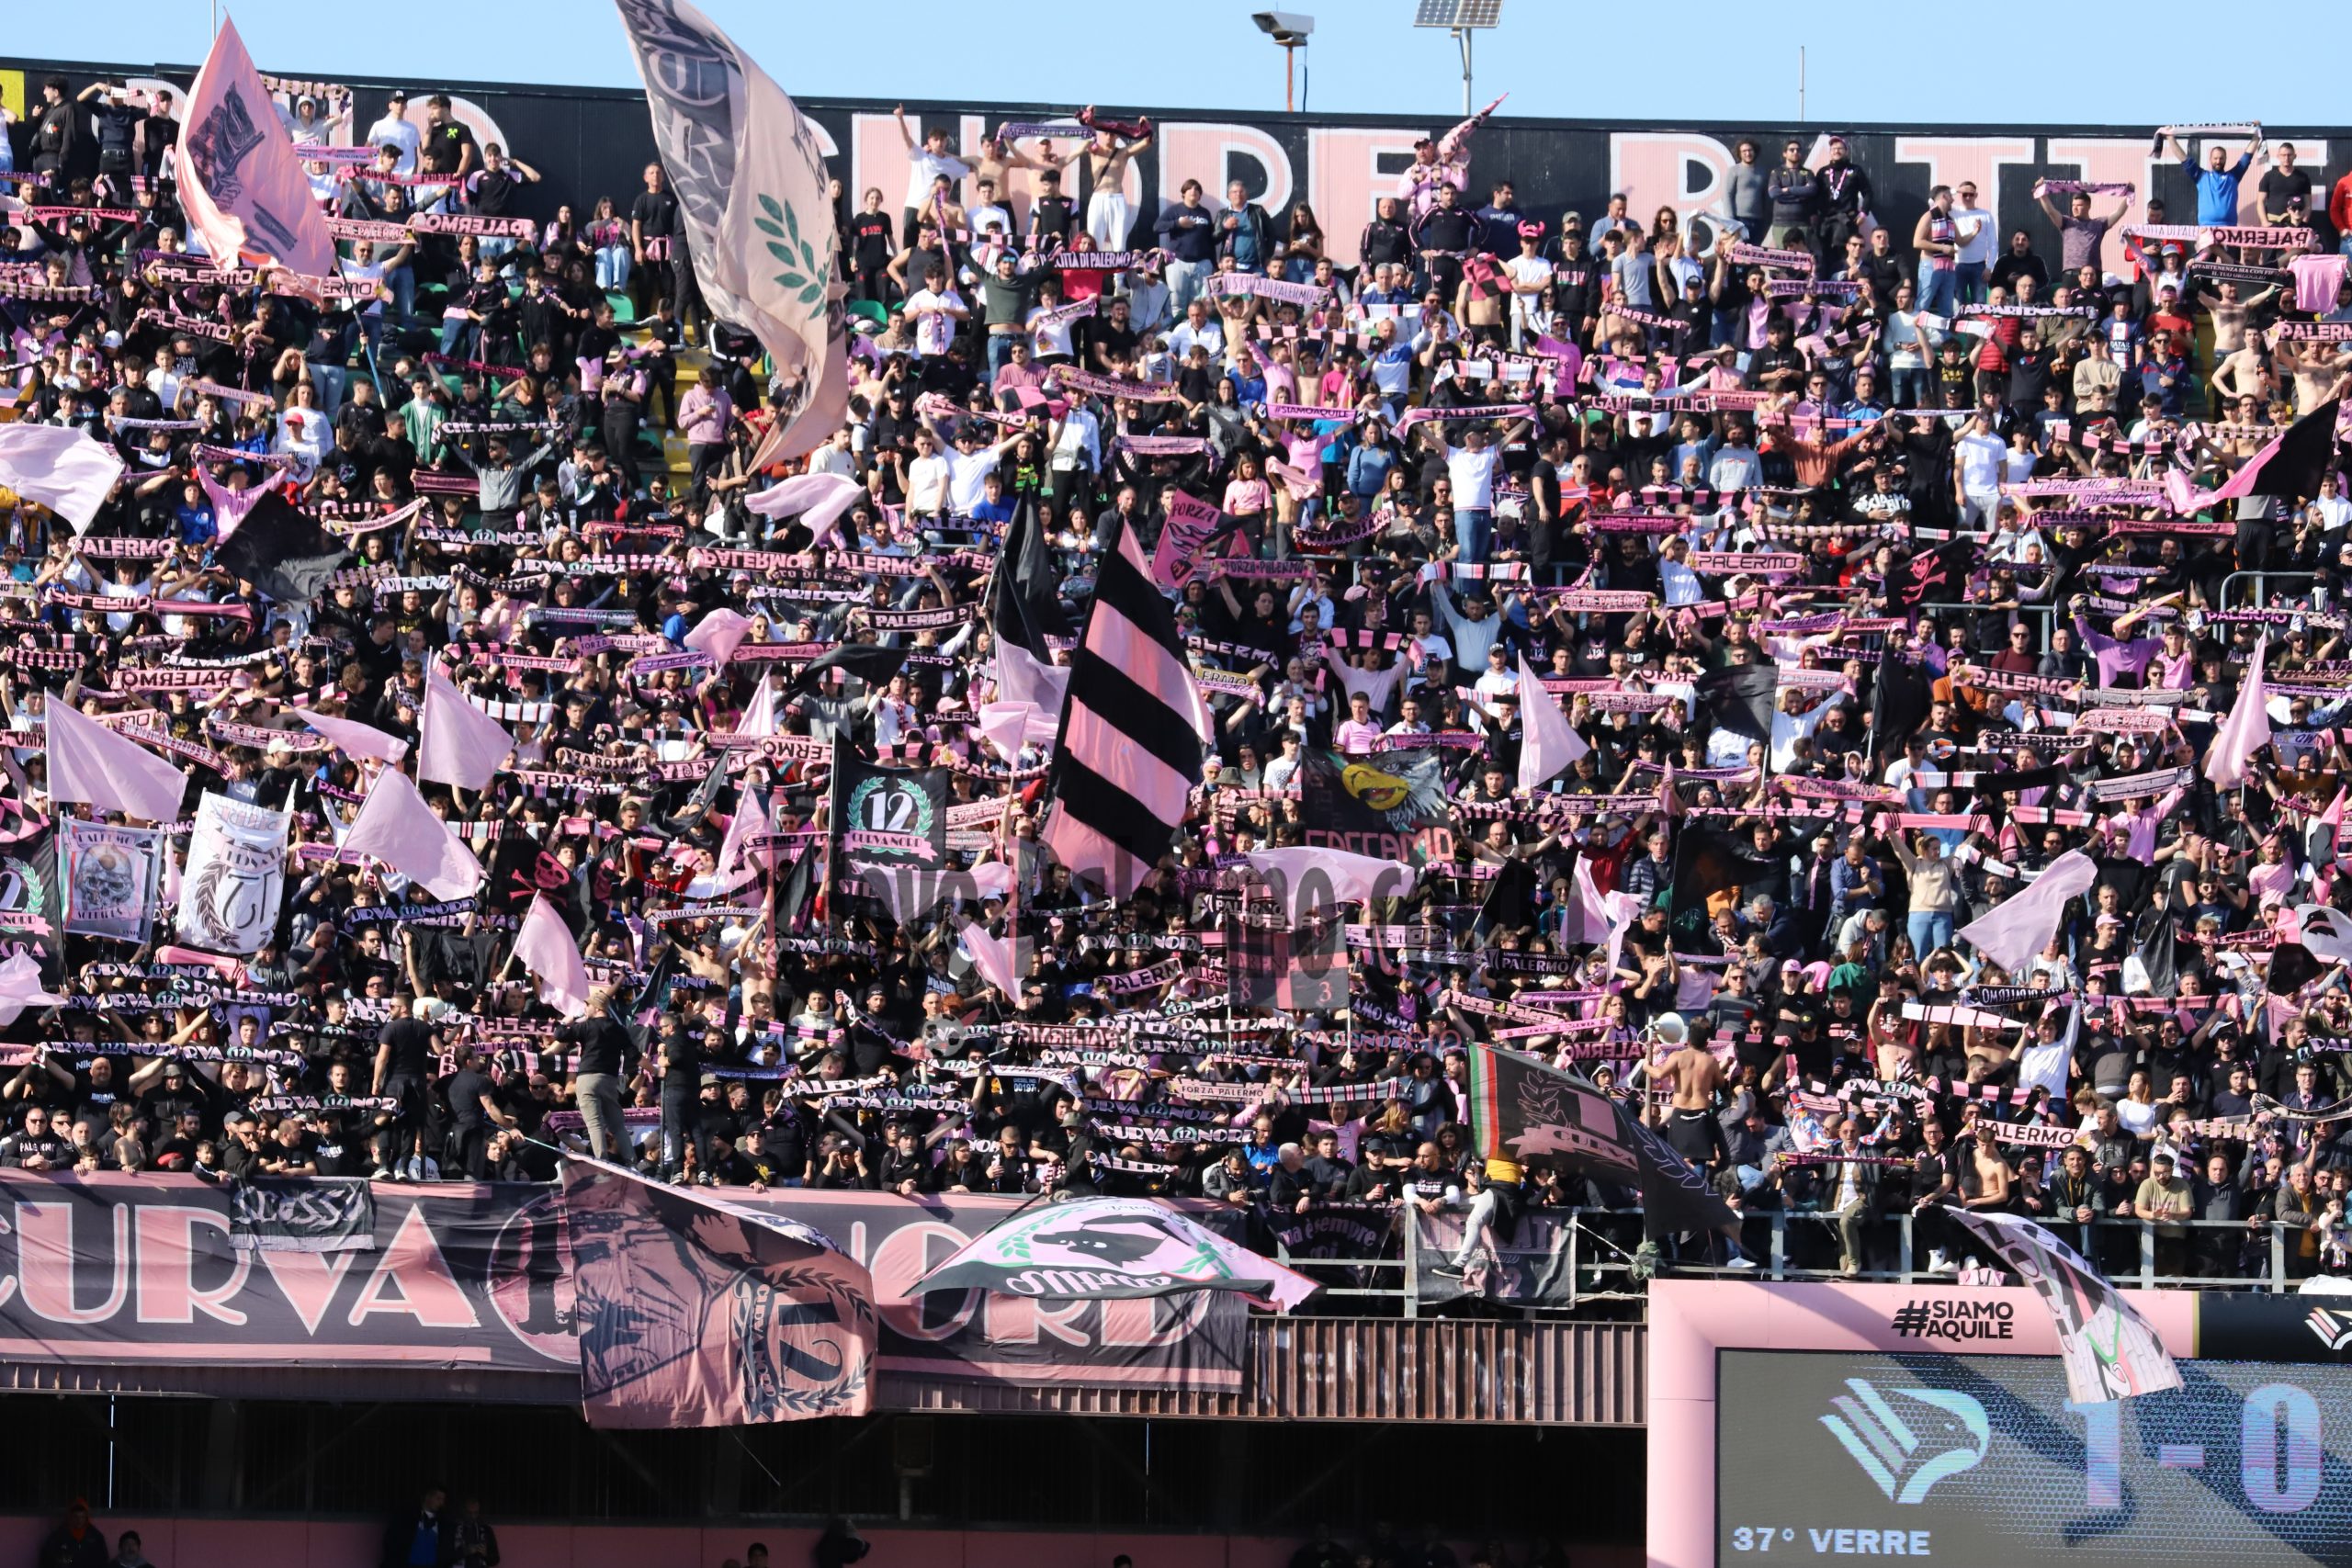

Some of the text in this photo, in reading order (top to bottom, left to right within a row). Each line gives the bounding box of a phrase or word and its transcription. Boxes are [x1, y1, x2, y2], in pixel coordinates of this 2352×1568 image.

[1091, 252, 1131, 269] PALERMO
[157, 268, 254, 287] PALERMO
[1274, 282, 1314, 303] PALERMO
[148, 310, 231, 341] PALERMO
[1432, 406, 1509, 420] PALERMO
[2045, 479, 2106, 491] PALERMO
[1171, 502, 1217, 524] FORZA
[919, 516, 992, 534] ALERM
[415, 529, 470, 544] URVA
[496, 531, 538, 545] NOR
[827, 551, 924, 575] PALERMO
[1699, 556, 1797, 570] PALERMO
[1598, 595, 1647, 606] PALERMO
[876, 611, 954, 626] PALERMO
[2207, 611, 2287, 624] PALERMO
[1187, 636, 1280, 671] ALERMO
[1567, 682, 1609, 691] PALERMO
[1973, 669, 2075, 695] PALERMO
[215, 722, 318, 747] PALERMO
[1985, 732, 2086, 747] PALERMO
[1795, 778, 1876, 796] FORZA PALERMO
[868, 791, 912, 833] 12
[1688, 807, 1836, 818] PALERMO
[852, 832, 923, 848] CURVA NORD
[3, 914, 36, 924] NORD
[351, 906, 398, 923] URVA
[421, 898, 476, 917] NORD
[90, 963, 145, 977] URVA
[1501, 958, 1568, 974] PALERMO
[98, 992, 153, 1010] URVA
[194, 980, 300, 1007] PALERMO
[1319, 981, 1332, 1003] 3
[1351, 997, 1382, 1021] AMO
[1452, 990, 1565, 1025] Forza Palermo
[39, 1041, 97, 1055] URVA
[1182, 1086, 1263, 1098] FORZA PALERMO
[824, 1096, 883, 1111] URVA
[1975, 1118, 2075, 1146] PALERMO
[0, 1201, 481, 1337] URVA
[1929, 1320, 2014, 1340] AQUILE
[2242, 1383, 2323, 1513] 0
[1733, 1527, 1930, 1555] 37° VERRE
